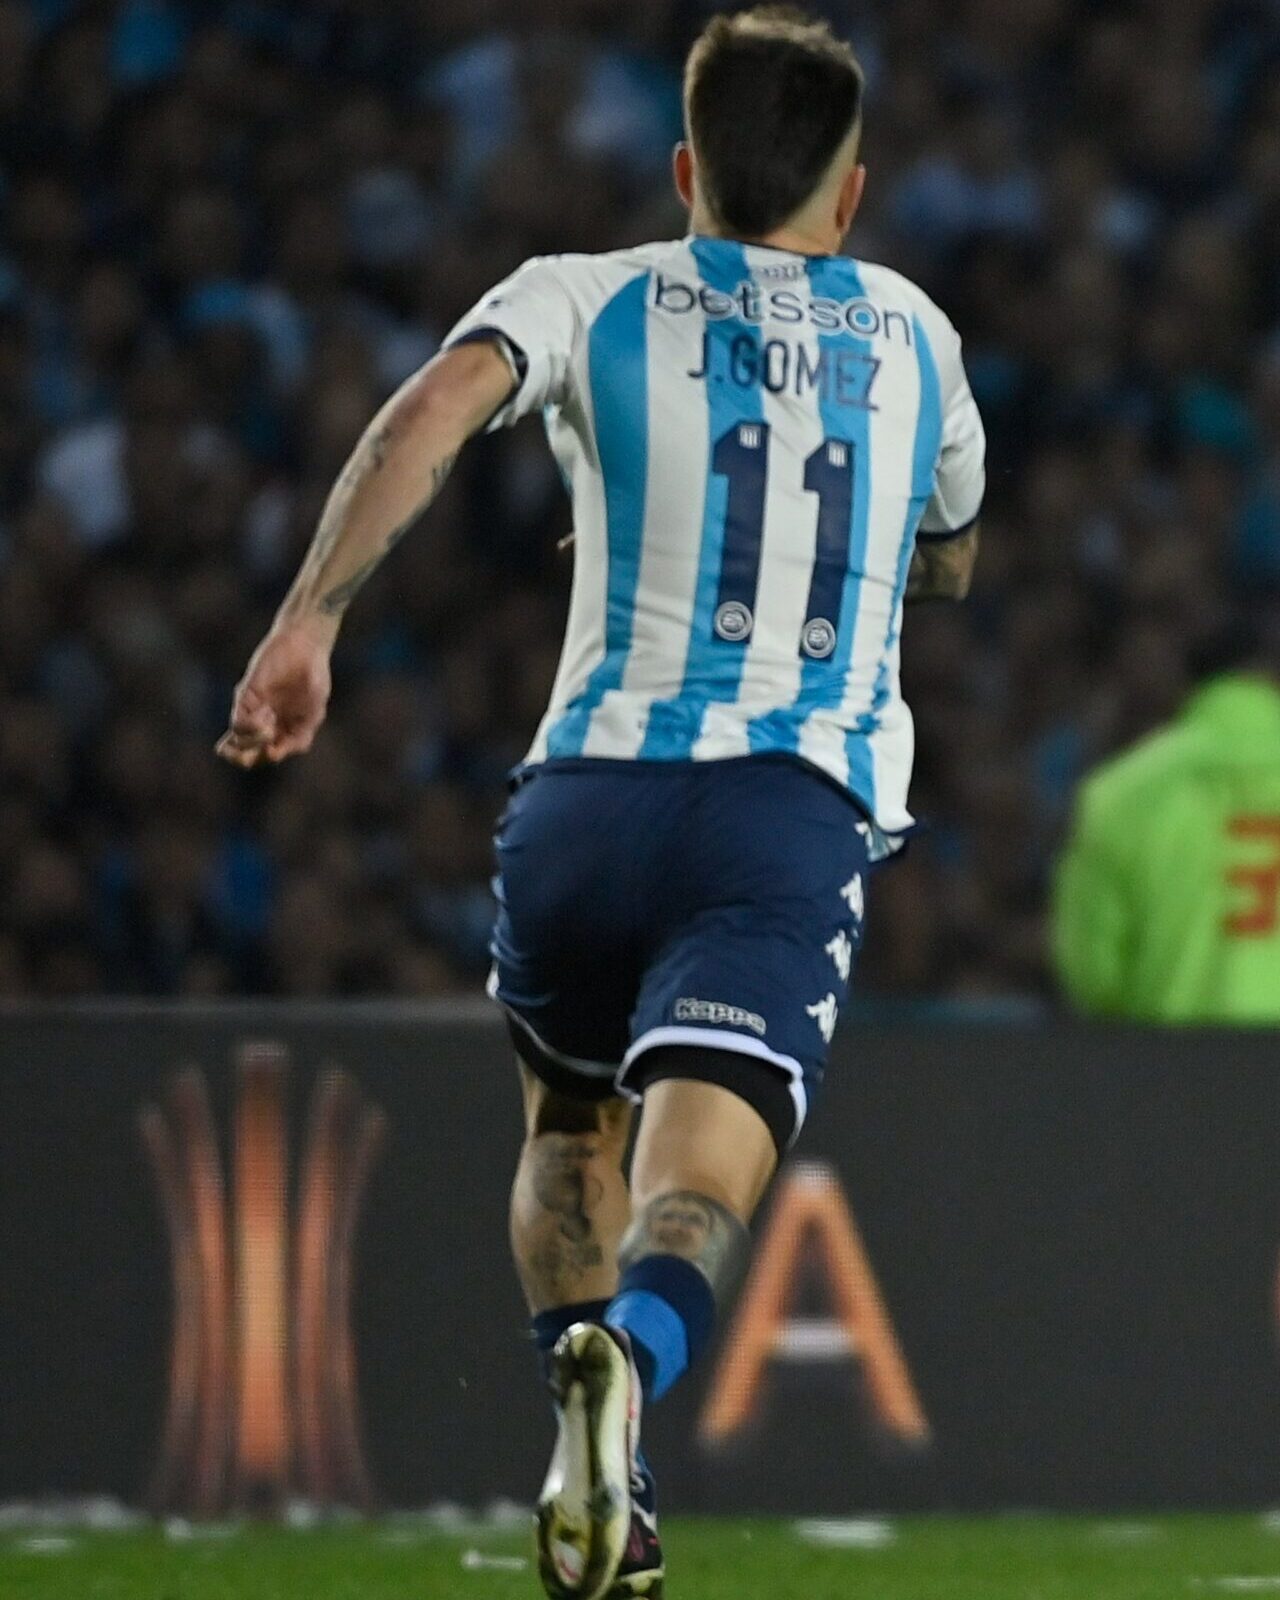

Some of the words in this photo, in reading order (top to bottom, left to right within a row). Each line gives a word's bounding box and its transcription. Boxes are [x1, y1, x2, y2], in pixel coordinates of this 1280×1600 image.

[654, 272, 912, 347] betsson
[687, 332, 882, 412] J.GOMEZ
[713, 420, 854, 662] 11
[675, 997, 767, 1036] Kappa
[698, 1160, 932, 1445] A
